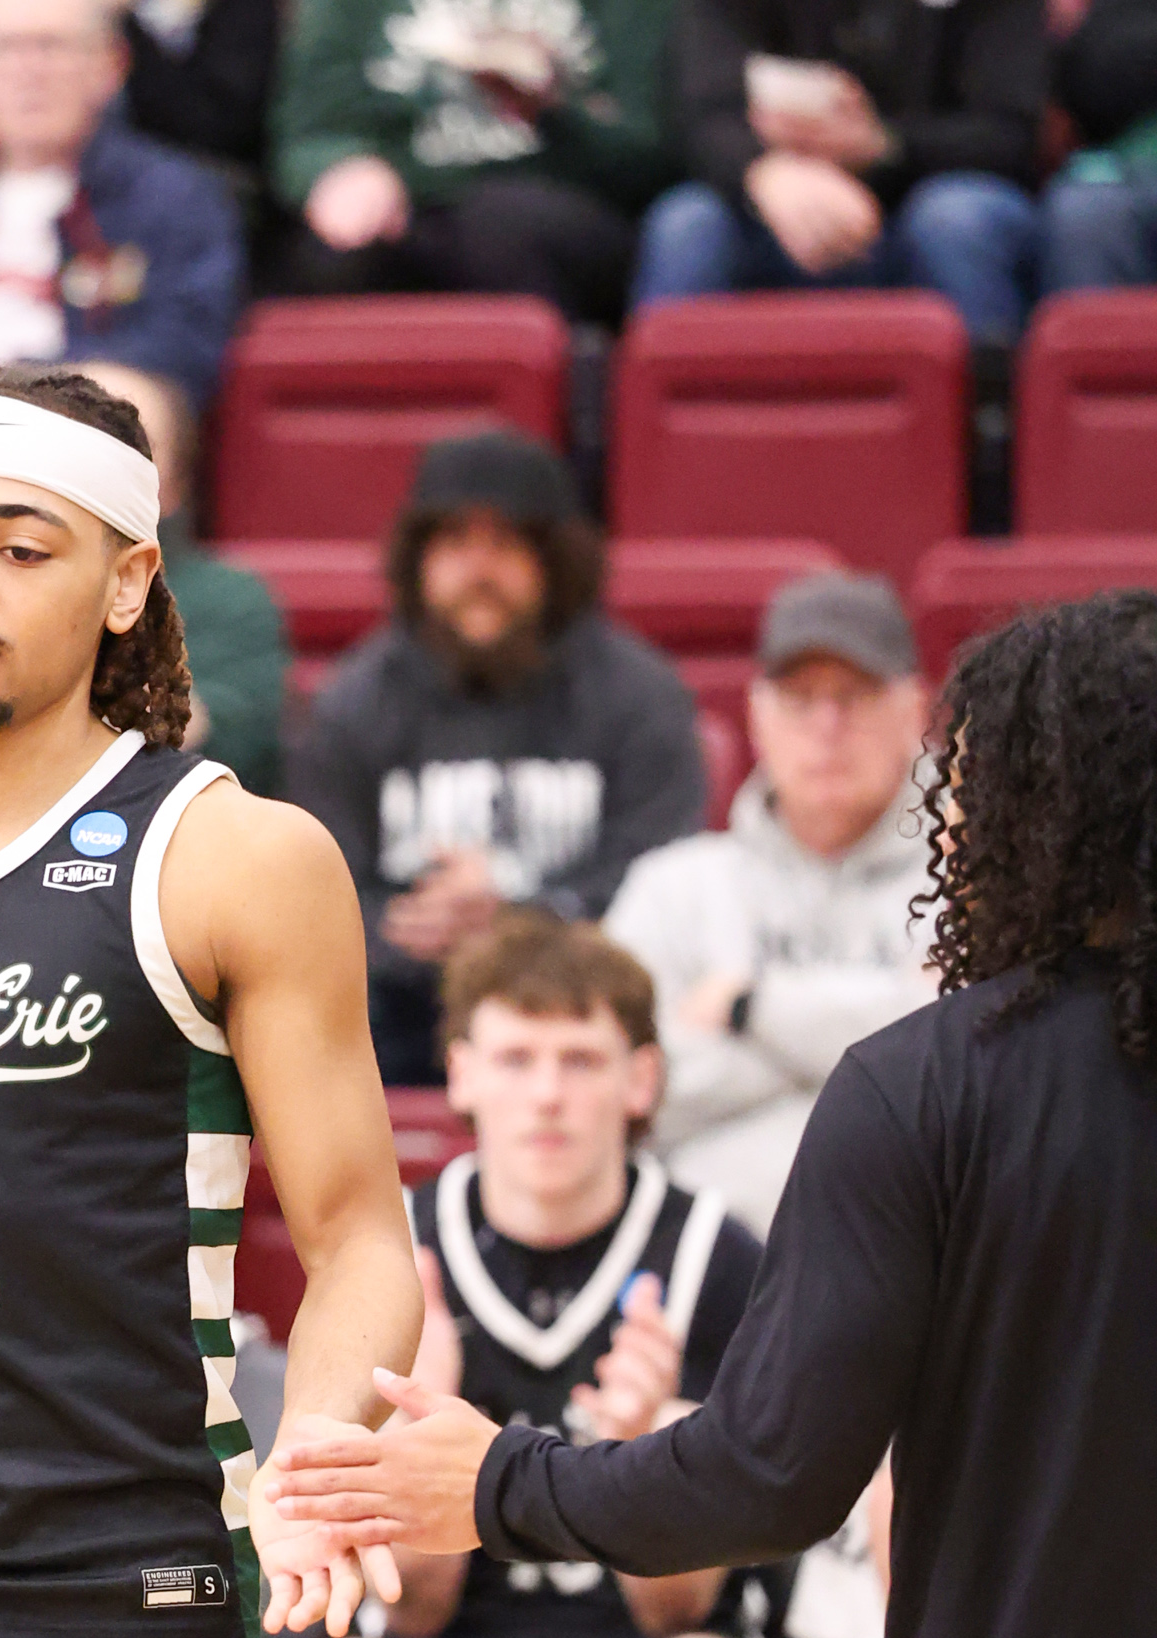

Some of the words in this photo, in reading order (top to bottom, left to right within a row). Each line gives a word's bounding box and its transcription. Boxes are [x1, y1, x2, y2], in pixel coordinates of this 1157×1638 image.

[76, 829, 122, 846] NCAA
[145, 1570, 192, 1580] ENGINEERED
[204, 1576, 216, 1595] S
